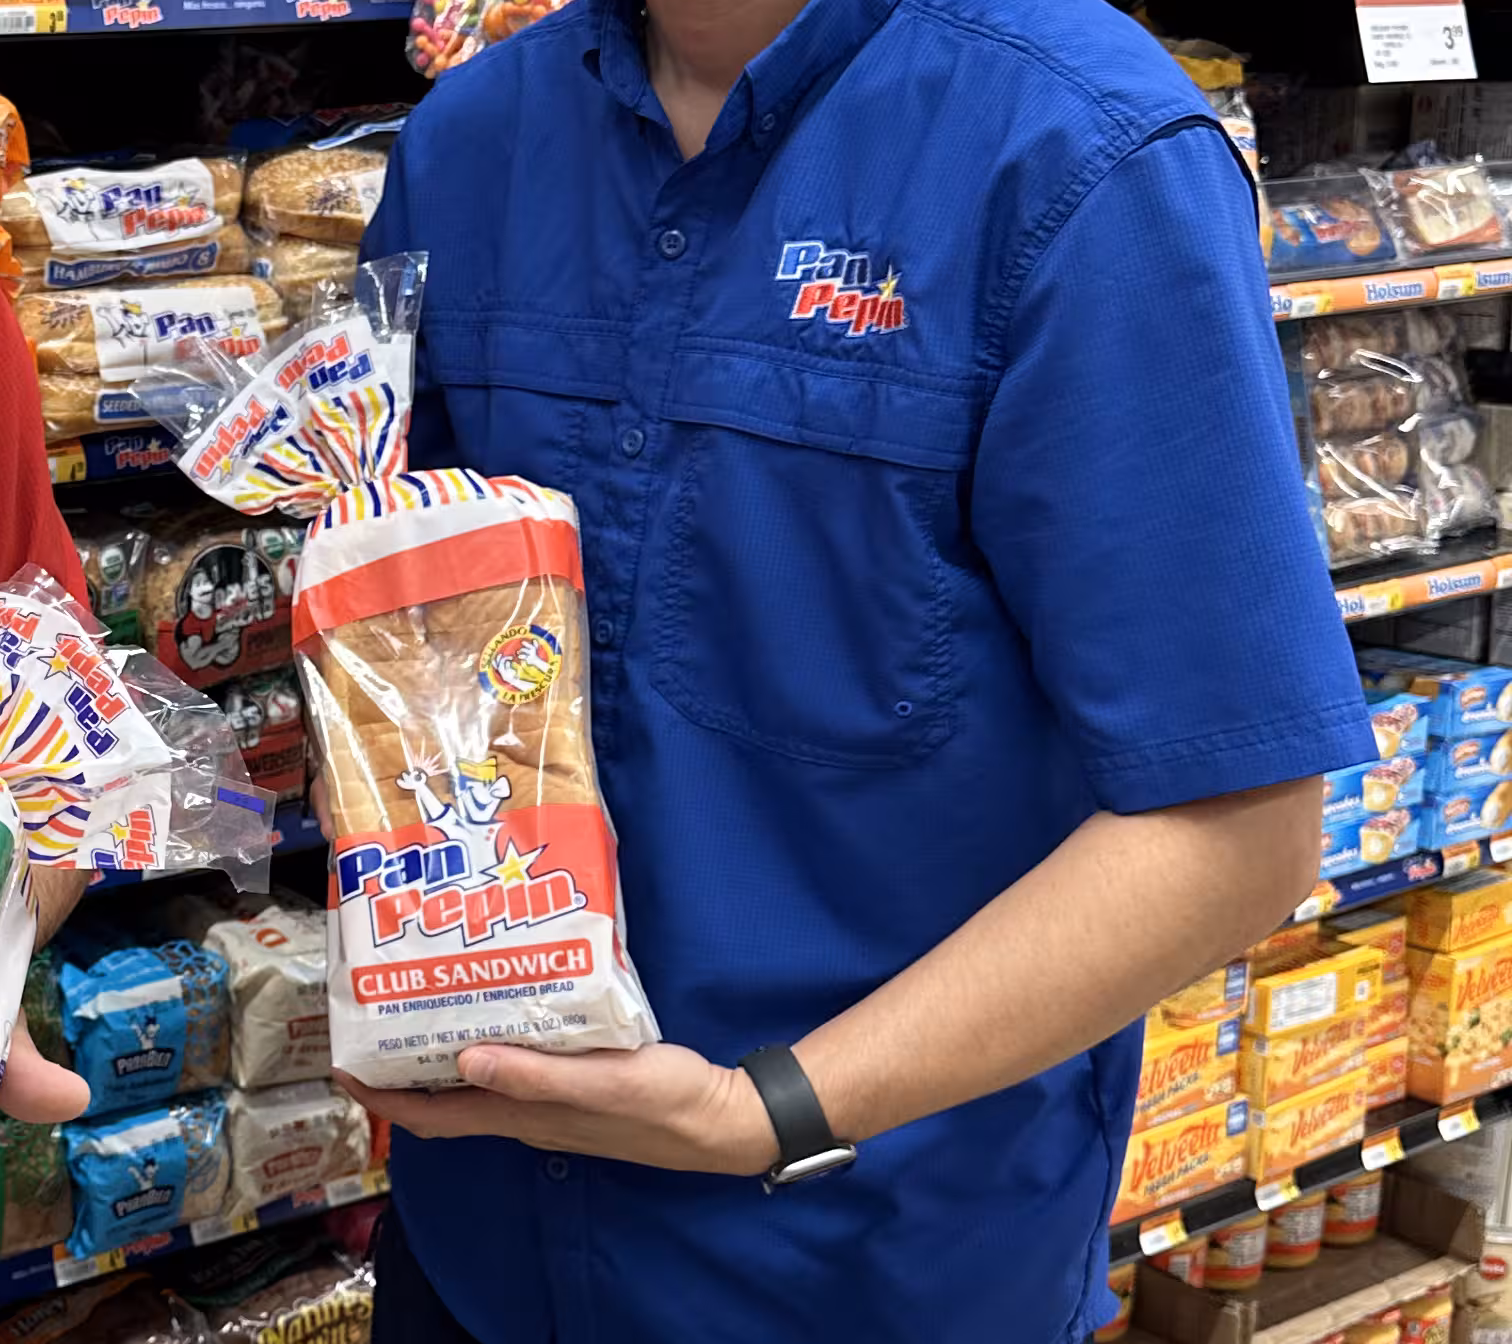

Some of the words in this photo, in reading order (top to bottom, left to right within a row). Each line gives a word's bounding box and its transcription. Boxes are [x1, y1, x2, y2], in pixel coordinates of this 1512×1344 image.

[99, 182, 162, 214] Pan
[774, 239, 872, 288] Pan
[788, 281, 906, 338] Pepin
[1364, 279, 1424, 302] Holsum
[153, 311, 218, 342] Pan
[308, 348, 375, 394] Pan
[1427, 571, 1482, 595] Holsum
[64, 682, 119, 758] Pan
[336, 838, 473, 904] Pan
[370, 868, 580, 949] Pepin
[357, 968, 426, 998] CLUB
[433, 947, 587, 989] SANDWICH
[378, 1003, 400, 1015] PAN
[402, 994, 473, 1013] ENRIQUECIDO
[483, 986, 537, 1002] ENRICHED
[539, 981, 575, 995] BREAD
[378, 1038, 402, 1052] PESO
[404, 1035, 429, 1049] NETO
[437, 1031, 454, 1044] NET
[1129, 1116, 1223, 1194] Velveeta
